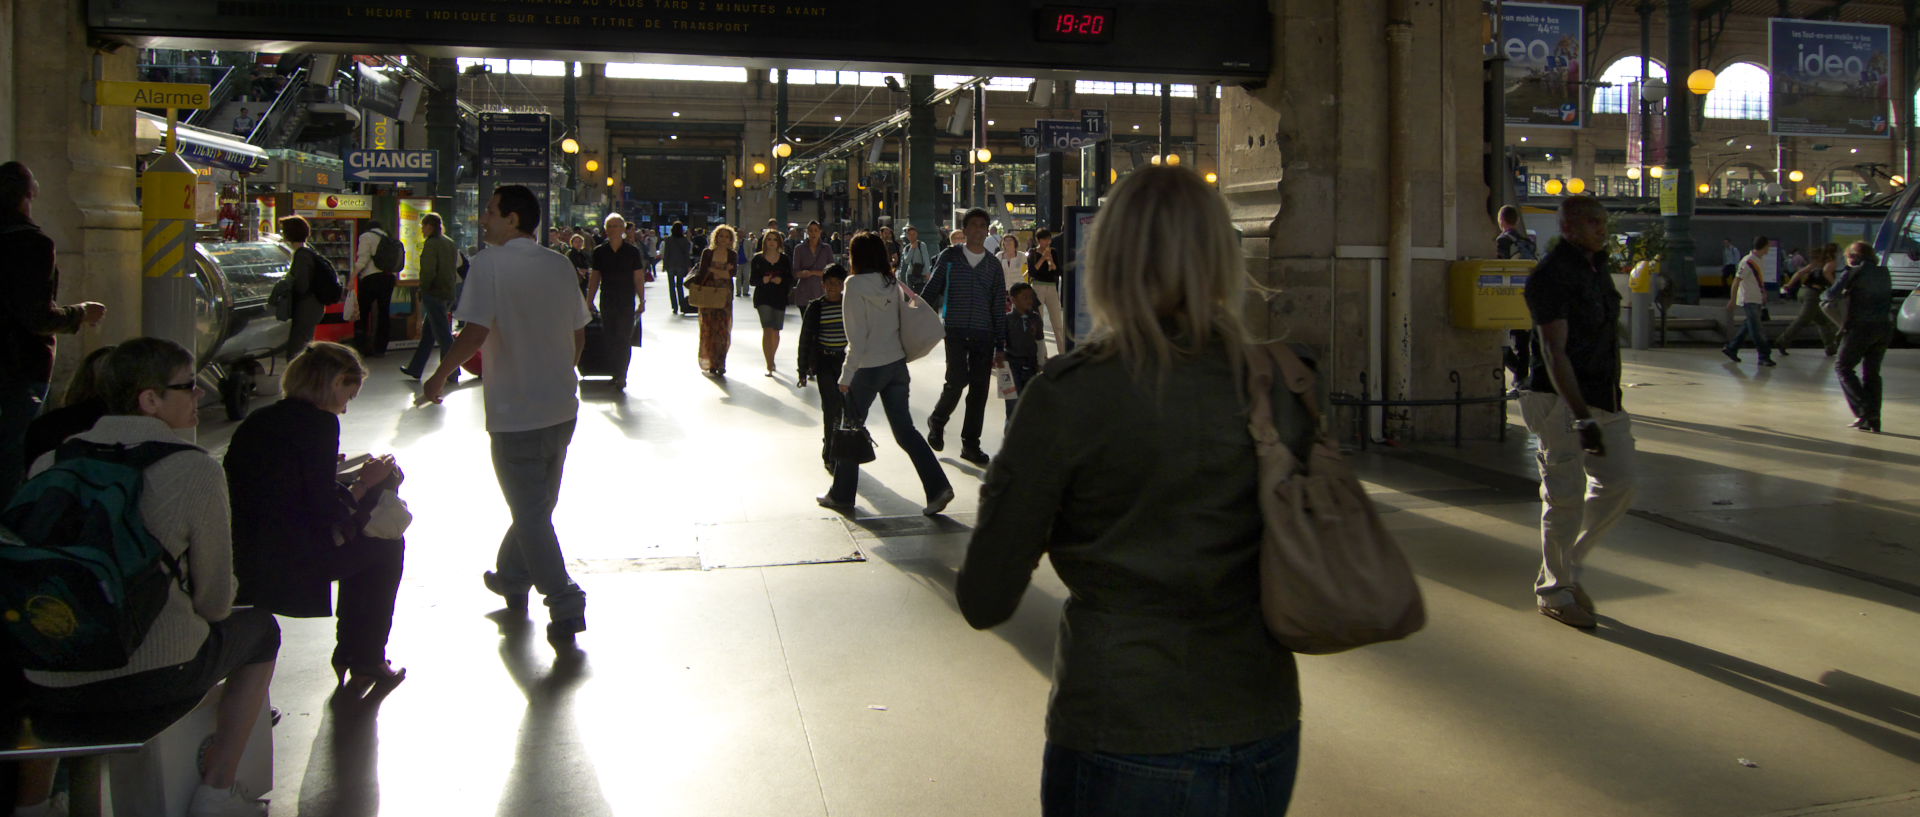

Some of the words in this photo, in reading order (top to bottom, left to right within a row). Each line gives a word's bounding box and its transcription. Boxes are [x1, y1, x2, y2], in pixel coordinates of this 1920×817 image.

[609, 0, 644, 8] PLUS
[656, 0, 689, 9] TARD
[698, 1, 706, 10] 2
[715, 3, 776, 14] MINUTES
[785, 6, 827, 16] AVANT
[366, 8, 412, 19] HEURE
[425, 10, 497, 22] INDIQUEE
[508, 13, 537, 23] SUR
[545, 15, 581, 25] LEUR
[592, 16, 636, 28] TITRE
[644, 18, 662, 29] DE
[672, 20, 752, 32] TRANSPORT
[1056, 14, 1104, 34] 19:20
[1516, 15, 1539, 23] mobile
[1547, 16, 1559, 24] box
[1797, 43, 1863, 77] ideo
[134, 89, 203, 105] Alarme
[1086, 118, 1099, 132] 11
[1023, 135, 1036, 148] 10
[349, 152, 432, 169] CHANGE
[195, 166, 212, 176] yal
[339, 198, 366, 207] selecta
